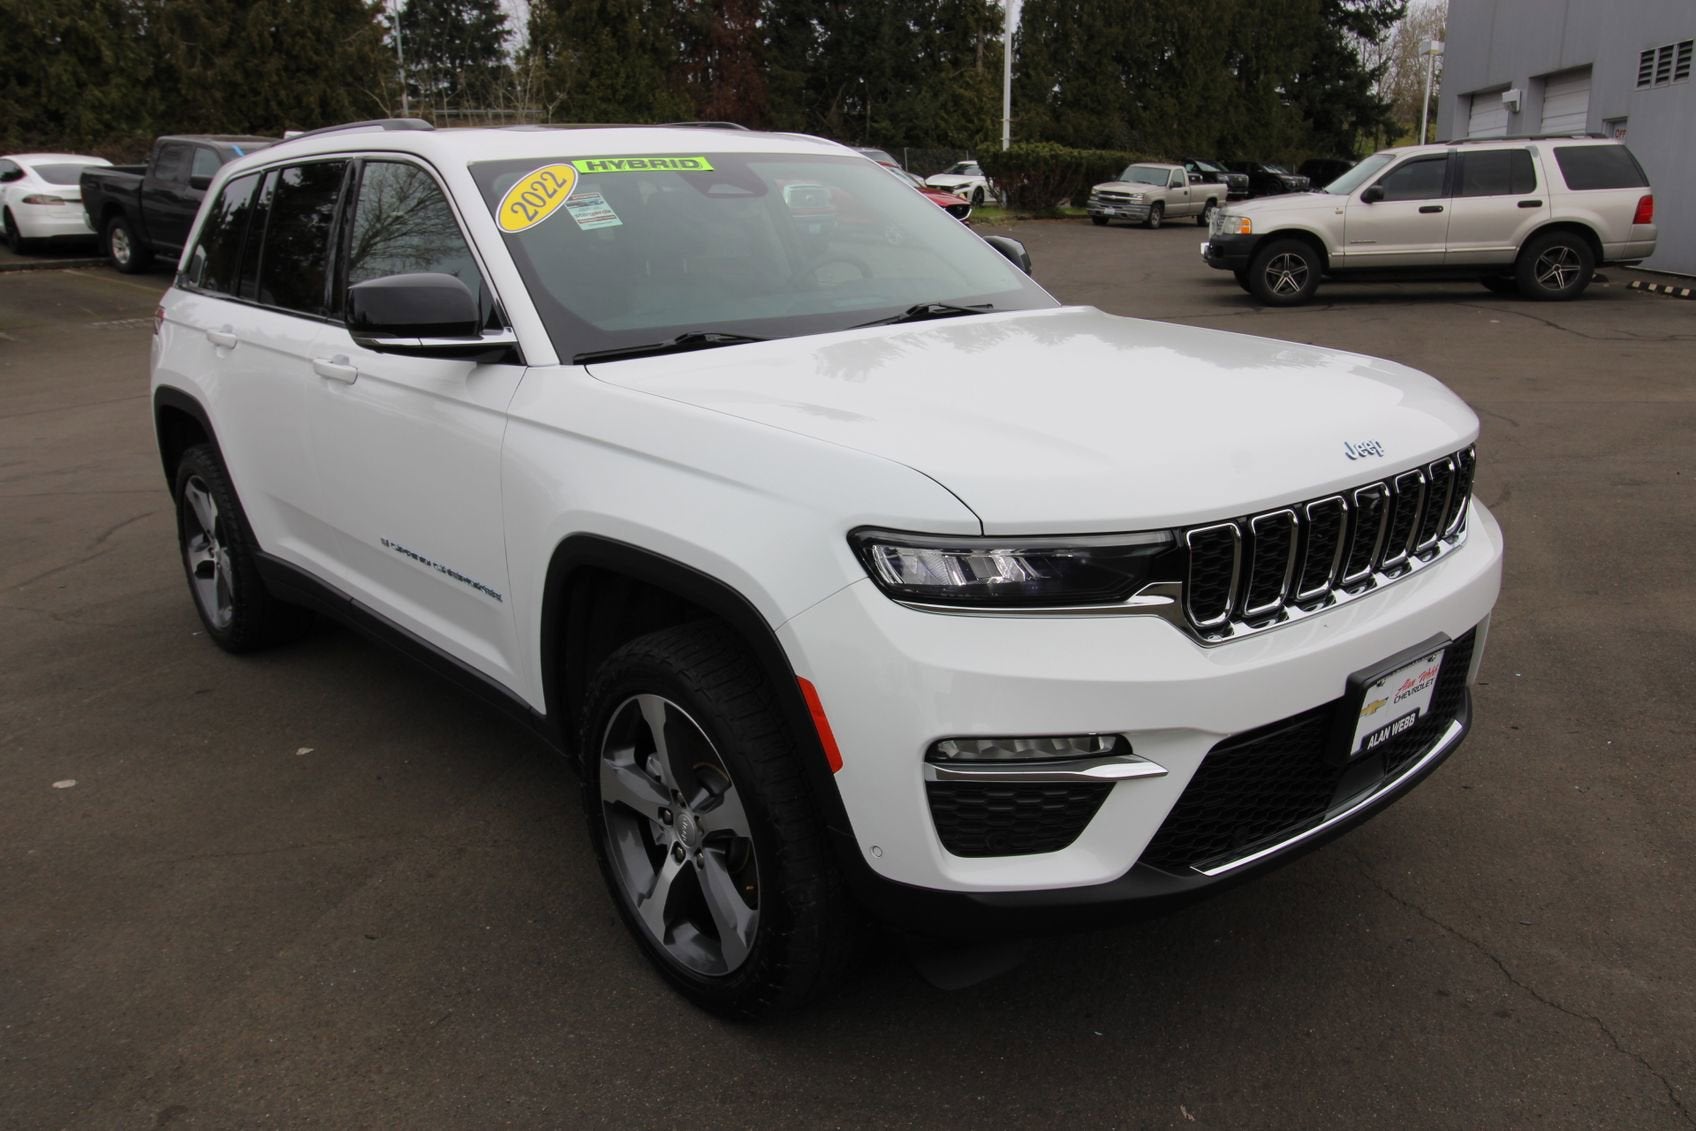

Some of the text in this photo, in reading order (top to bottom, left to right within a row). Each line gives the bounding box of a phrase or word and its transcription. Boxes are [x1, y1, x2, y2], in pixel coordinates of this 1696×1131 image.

[586, 160, 700, 170] HYBRID
[511, 171, 567, 221] 2022
[1344, 440, 1384, 460] Jeep
[1393, 678, 1434, 704] CHEVROLET
[1367, 713, 1416, 750] ALAN WEBB
